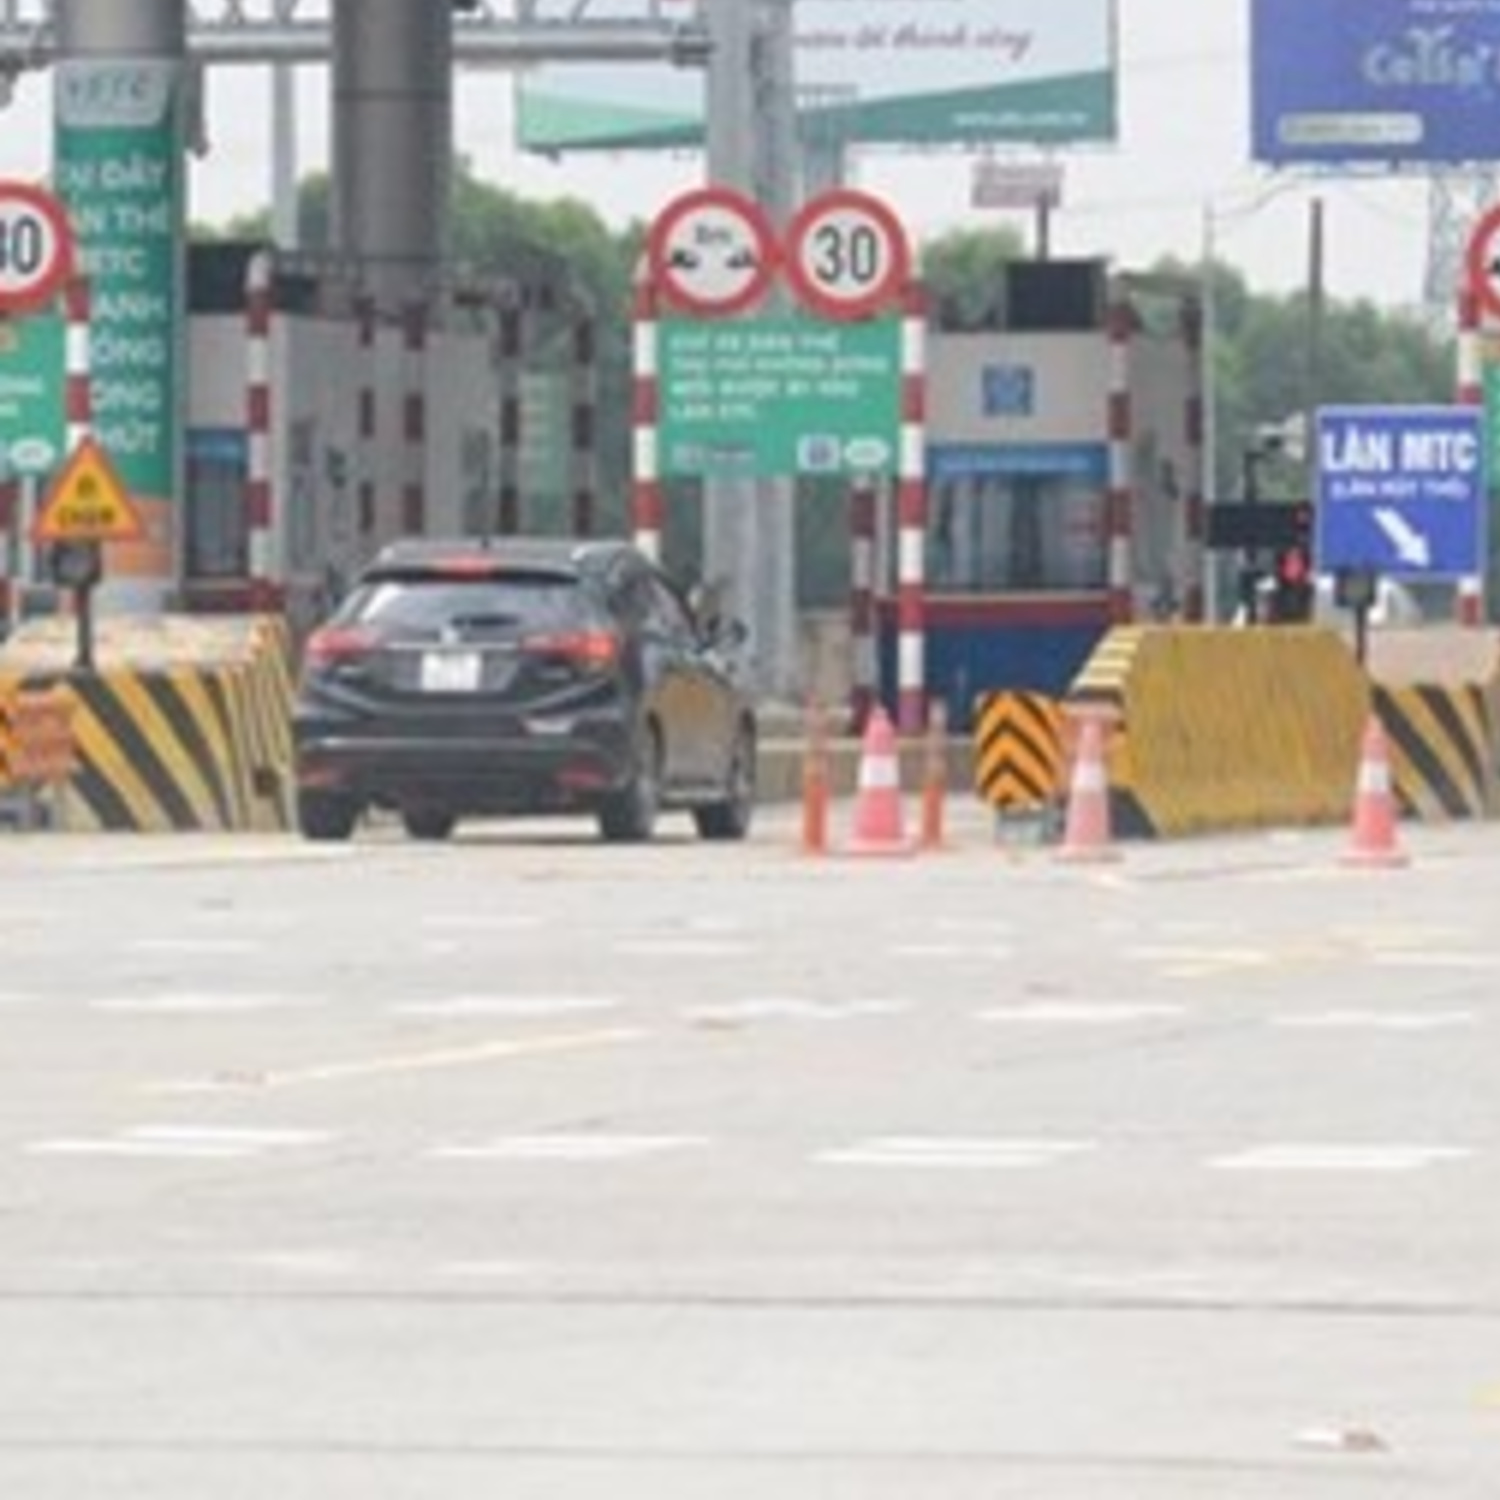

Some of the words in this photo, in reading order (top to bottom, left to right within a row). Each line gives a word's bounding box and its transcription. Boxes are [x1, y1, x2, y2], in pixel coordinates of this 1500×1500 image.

[0, 214, 42, 276] 0
[813, 223, 880, 285] 30
[1321, 422, 1394, 472] LÀN
[1401, 430, 1480, 472] MTC
